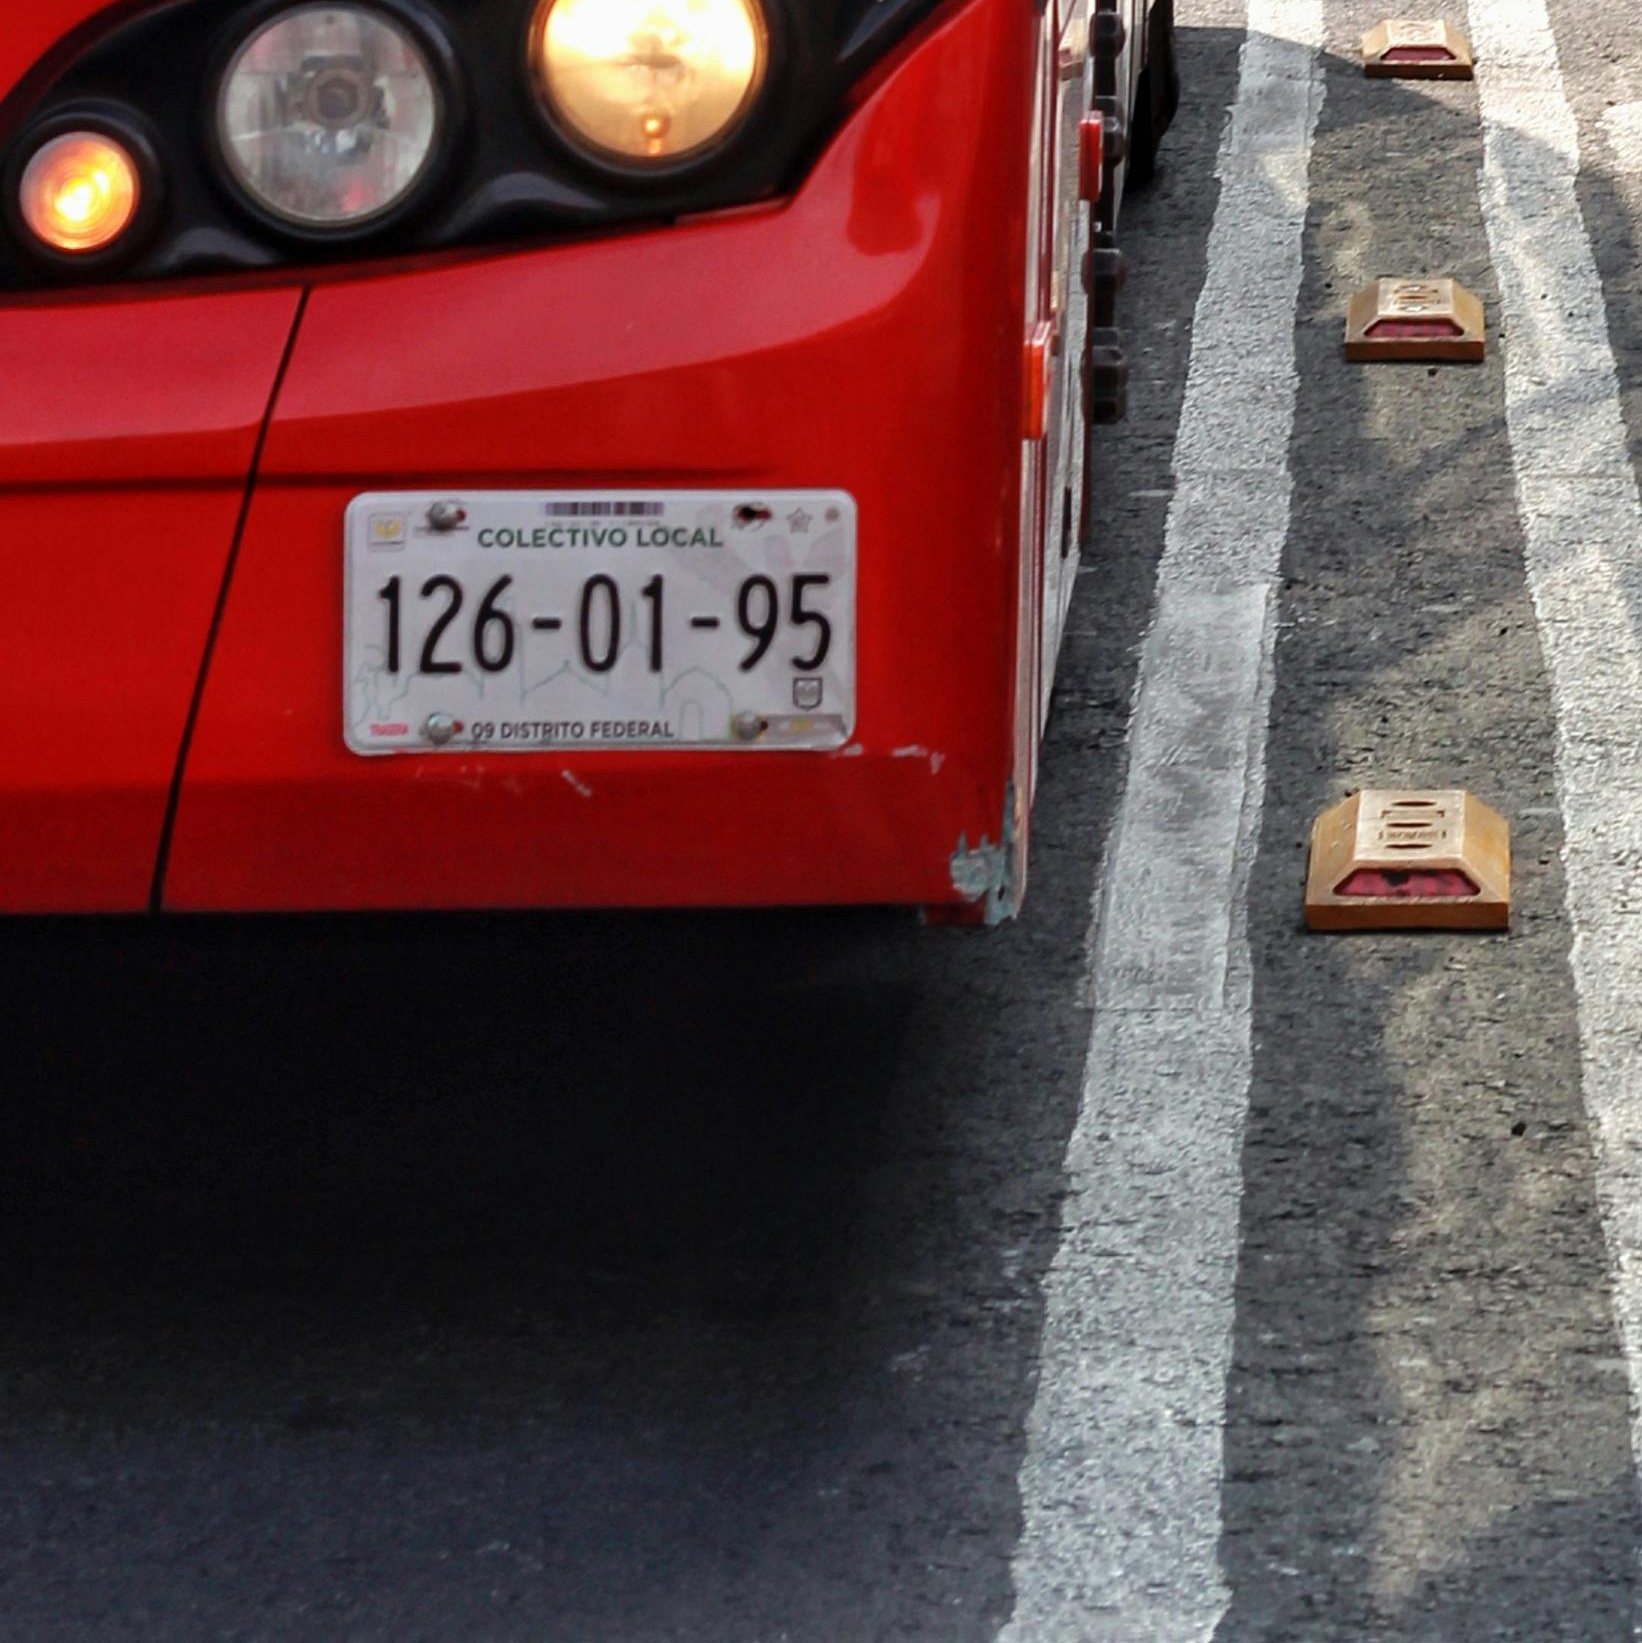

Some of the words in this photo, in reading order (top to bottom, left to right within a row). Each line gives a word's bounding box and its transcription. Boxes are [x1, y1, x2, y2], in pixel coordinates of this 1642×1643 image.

[477, 526, 627, 549] COLECTIVO
[636, 526, 724, 549] LOCAL
[378, 573, 832, 674] 126-01-95
[501, 721, 584, 740] DISTRITO
[591, 721, 674, 740] FEDERAL
